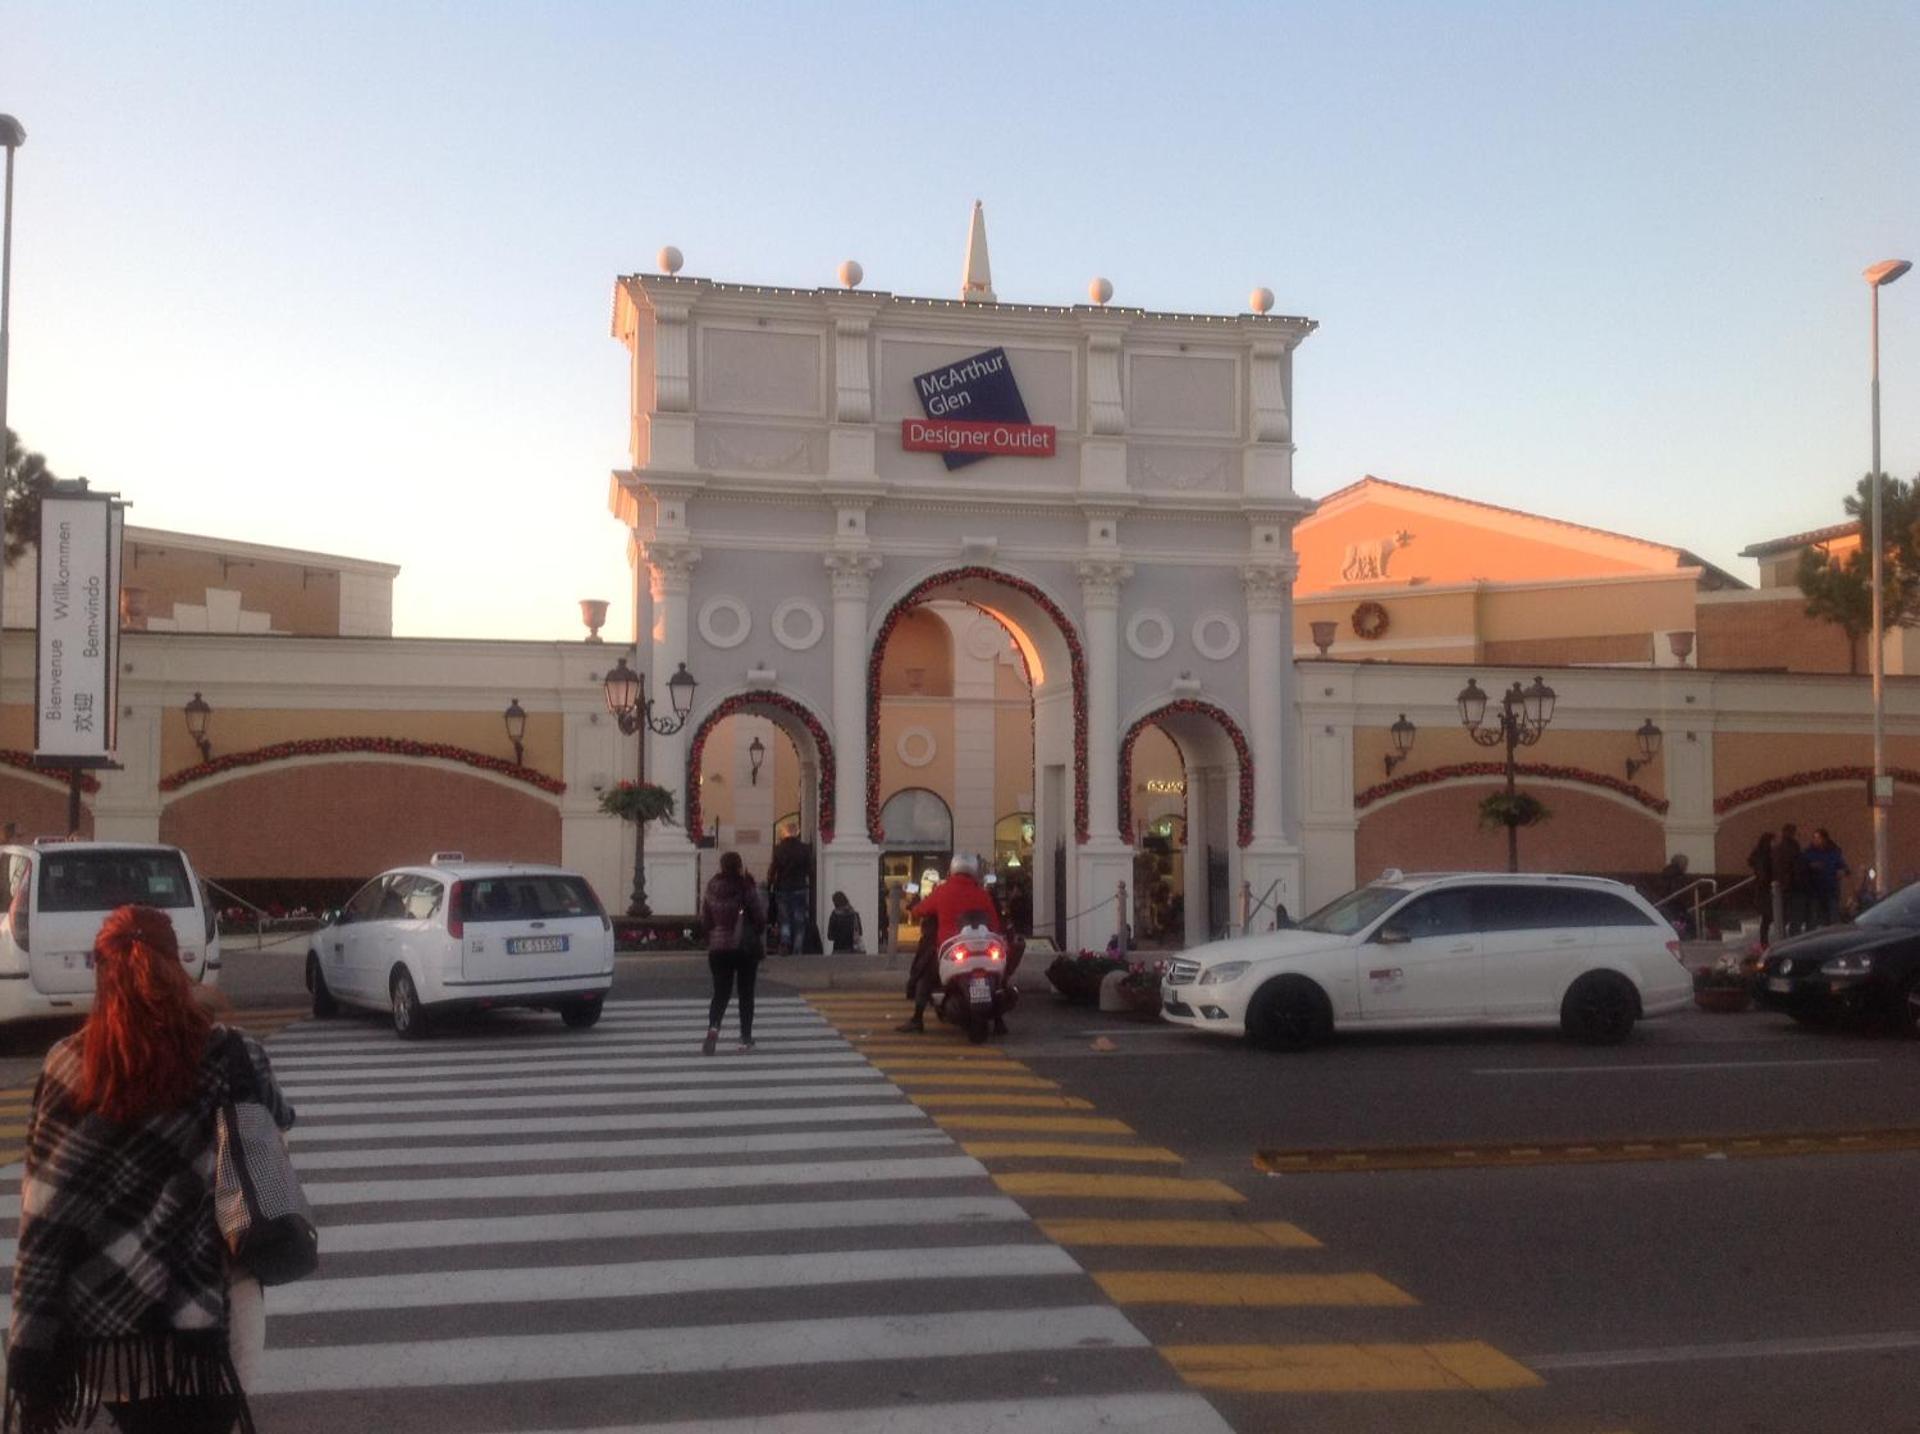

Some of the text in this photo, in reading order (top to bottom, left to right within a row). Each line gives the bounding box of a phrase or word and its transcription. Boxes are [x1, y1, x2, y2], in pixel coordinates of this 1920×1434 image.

[920, 354, 1004, 396] McArthur
[929, 391, 972, 416] Glen
[910, 424, 1049, 449] Designer Outlet
[53, 521, 70, 621] Willkommen
[83, 575, 100, 659] Bem-vindo
[46, 638, 63, 721] Bienvenue
[75, 692, 93, 733] 欢迎
